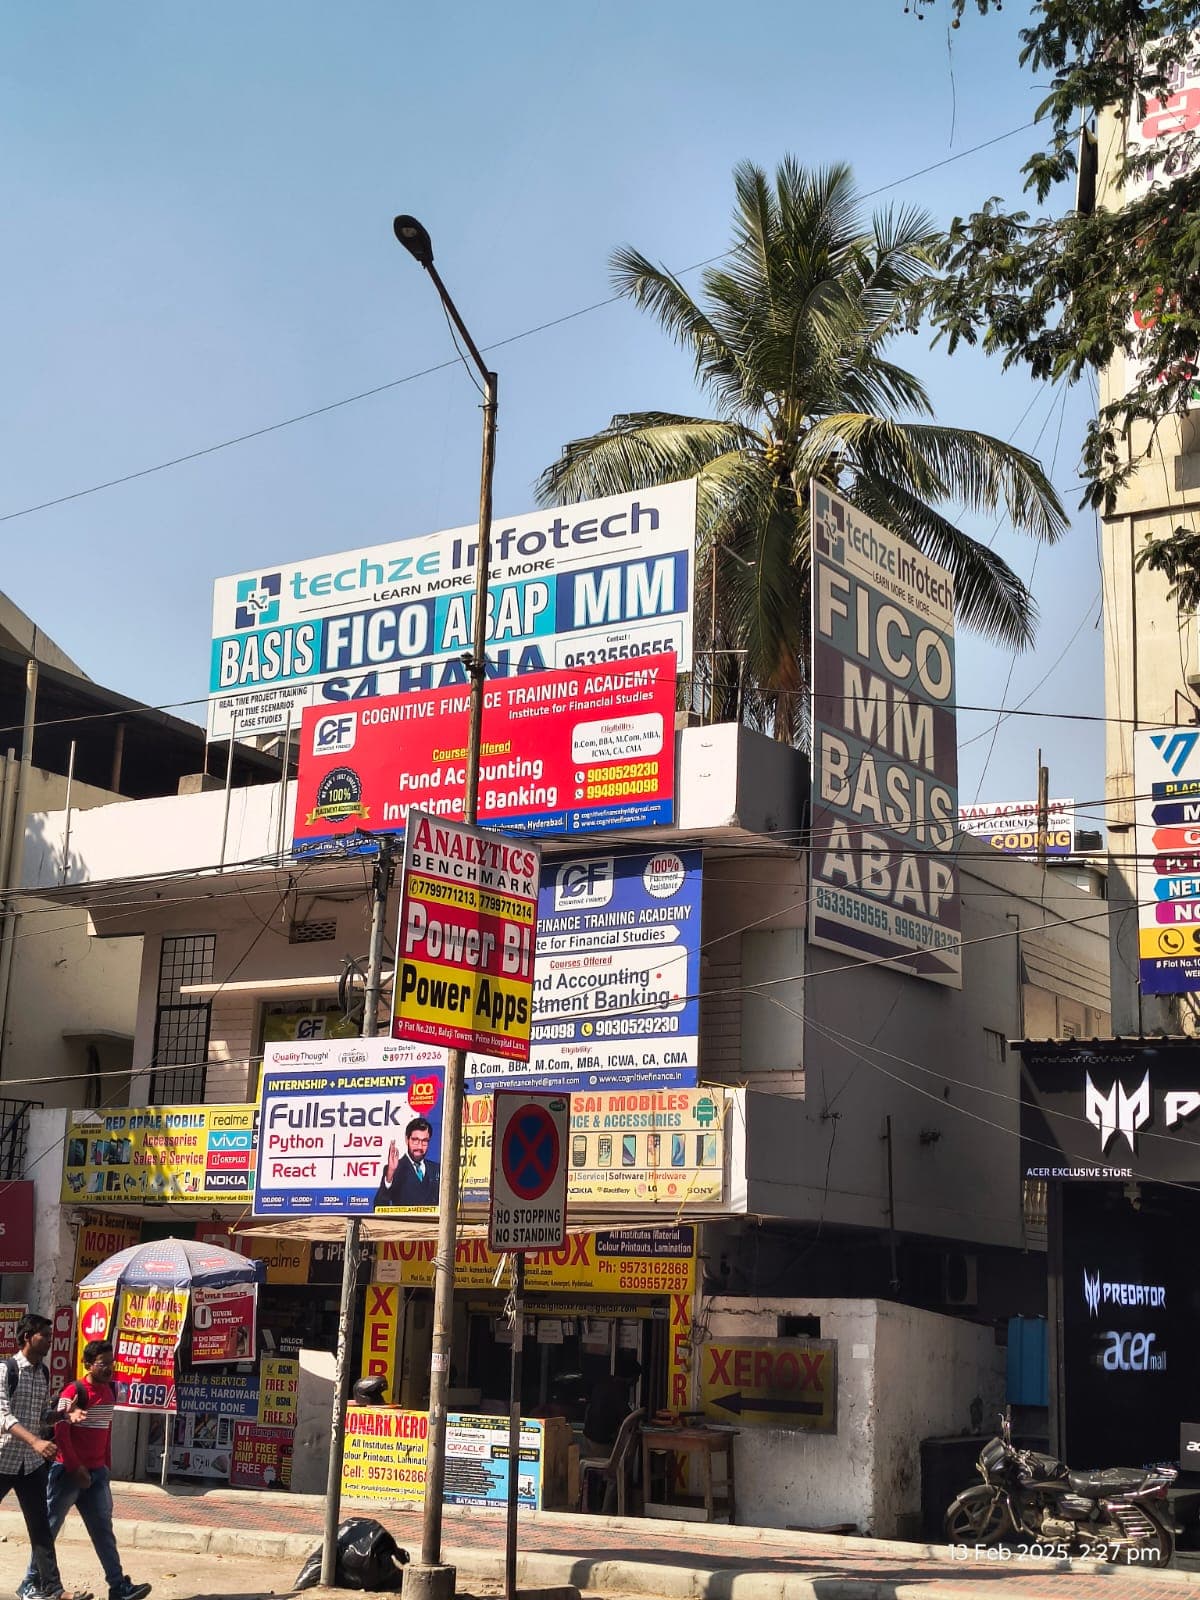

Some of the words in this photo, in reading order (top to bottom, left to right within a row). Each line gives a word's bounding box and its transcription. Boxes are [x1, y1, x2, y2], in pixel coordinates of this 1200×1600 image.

[289, 551, 440, 600] techze
[452, 502, 660, 570] Infotech
[845, 513, 896, 576] techze
[897, 547, 953, 613] Infotech
[372, 585, 421, 601] LEARN
[508, 559, 555, 577] MORE
[872, 571, 890, 591] LEARN
[219, 624, 314, 688] BASIS
[326, 603, 429, 671] FICO
[441, 582, 549, 650] ABAP
[573, 557, 677, 629] MM
[818, 560, 953, 701] FICO
[321, 671, 381, 702] S4
[399, 645, 546, 696] HANA
[251, 691, 277, 704] PROJECT
[279, 686, 308, 698] TRAINING
[361, 701, 435, 726] COGNITIVE
[439, 691, 503, 716] FINACE
[507, 680, 578, 706] TRAINING
[584, 668, 660, 695] ACADEMY
[509, 706, 550, 719] Institute
[552, 702, 566, 714] for
[569, 696, 613, 711] Financial
[616, 690, 654, 704] Studies
[240, 718, 256, 727] CASE
[257, 713, 282, 725] STUDIES
[842, 656, 935, 773] MM
[400, 768, 441, 791] Fund
[444, 757, 543, 786] Acounting
[587, 761, 659, 783] 9030529230
[329, 788, 351, 802] 100%
[485, 783, 558, 810] Banking
[586, 778, 659, 799] 9948904098
[820, 731, 955, 852] BASIS
[412, 817, 536, 879] ANALYTICS
[990, 831, 1071, 850] CODING
[412, 853, 532, 896] BENCHMARK
[649, 858, 680, 874] 100%
[820, 817, 955, 919] ABAP
[418, 879, 478, 908] 7799771213,
[479, 894, 533, 919] 7799771214
[536, 914, 581, 934] FINANCE
[584, 909, 636, 929] TRAINING
[638, 905, 692, 924] ACADEMY
[405, 900, 496, 969] Power
[501, 922, 532, 978] BI
[550, 935, 566, 949] for
[569, 931, 620, 948] Financial
[622, 928, 666, 943] Studies
[549, 959, 581, 970] Courses
[583, 955, 613, 967] Offered
[556, 968, 650, 990] Accounting
[400, 963, 472, 1014] Power
[475, 978, 529, 1031] Apps
[594, 988, 671, 1011] Banking
[595, 1016, 679, 1036] 9030529230
[491, 1035, 512, 1049] Hospital
[389, 1052, 413, 1062] 89771
[416, 1051, 442, 1060] 69236
[471, 1062, 504, 1075] B.Com,
[508, 1059, 531, 1073] BBA,
[534, 1058, 573, 1072] M.Com,
[576, 1056, 604, 1070] MBA,
[607, 1054, 638, 1068] ICWA,
[642, 1053, 659, 1066] CA,
[663, 1051, 688, 1065] CMA
[268, 1078, 328, 1091] INTERNSHIP
[337, 1075, 406, 1089] PLACEMENTS
[573, 1097, 603, 1113] SAI
[608, 1094, 689, 1112] MOBILES
[105, 1115, 126, 1131] RED
[129, 1114, 163, 1130] APPLE
[165, 1113, 206, 1129] MOBILE
[213, 1114, 249, 1127] realme
[269, 1100, 401, 1129] Fullstack
[592, 1114, 601, 1128] &
[603, 1112, 682, 1128] ACCESSORIES
[142, 1133, 198, 1148] Accessories
[211, 1133, 248, 1147] vivo
[268, 1135, 324, 1152] Python
[343, 1132, 383, 1148] Java
[133, 1151, 158, 1166] Sales
[169, 1151, 204, 1166] Service
[272, 1162, 317, 1178] React
[343, 1161, 381, 1177] .NET
[1026, 1167, 1050, 1177] ACER
[1052, 1167, 1101, 1177] EXCLUSIVE
[1102, 1167, 1133, 1177] STORE
[205, 1175, 247, 1186] NOKIA
[647, 1185, 658, 1193] LG
[495, 1211, 510, 1225] NO
[513, 1209, 561, 1225] STOPPING
[495, 1228, 510, 1243] NO
[512, 1227, 561, 1243] STANDING
[620, 1229, 651, 1240] Institutes
[652, 1229, 680, 1240] Material
[382, 1238, 489, 1264] KONRK
[597, 1241, 619, 1251] Colour
[620, 1241, 653, 1254] Printouts,
[654, 1242, 692, 1253] Lamination
[598, 1260, 616, 1274] Ph:
[619, 1261, 689, 1275] 9573162868
[619, 1276, 689, 1290] 6309557287
[129, 1295, 145, 1311] All
[146, 1296, 183, 1313] Mobiles
[1102, 1282, 1167, 1310] PREDATOR
[85, 1312, 106, 1334] Jio
[123, 1312, 160, 1329] Service
[118, 1340, 141, 1357] BIG
[1103, 1330, 1156, 1371] acer
[1150, 1351, 1167, 1370] mall
[707, 1347, 825, 1392] XEROX
[210, 1376, 248, 1387] SERVICE
[265, 1378, 285, 1392] FREE
[181, 1400, 219, 1412] UNLOCK
[220, 1402, 246, 1413] DONE
[263, 1410, 283, 1423] FREE
[394, 1415, 428, 1440] XERO
[236, 1440, 253, 1452] SIM
[255, 1442, 278, 1453] FREE
[351, 1438, 361, 1448] All
[362, 1440, 394, 1450] Institutes
[395, 1442, 424, 1453] Material
[446, 1443, 486, 1453] ORACLE
[236, 1463, 260, 1474] FREE
[255, 1454, 278, 1465] FREE
[343, 1464, 365, 1479] Cell:
